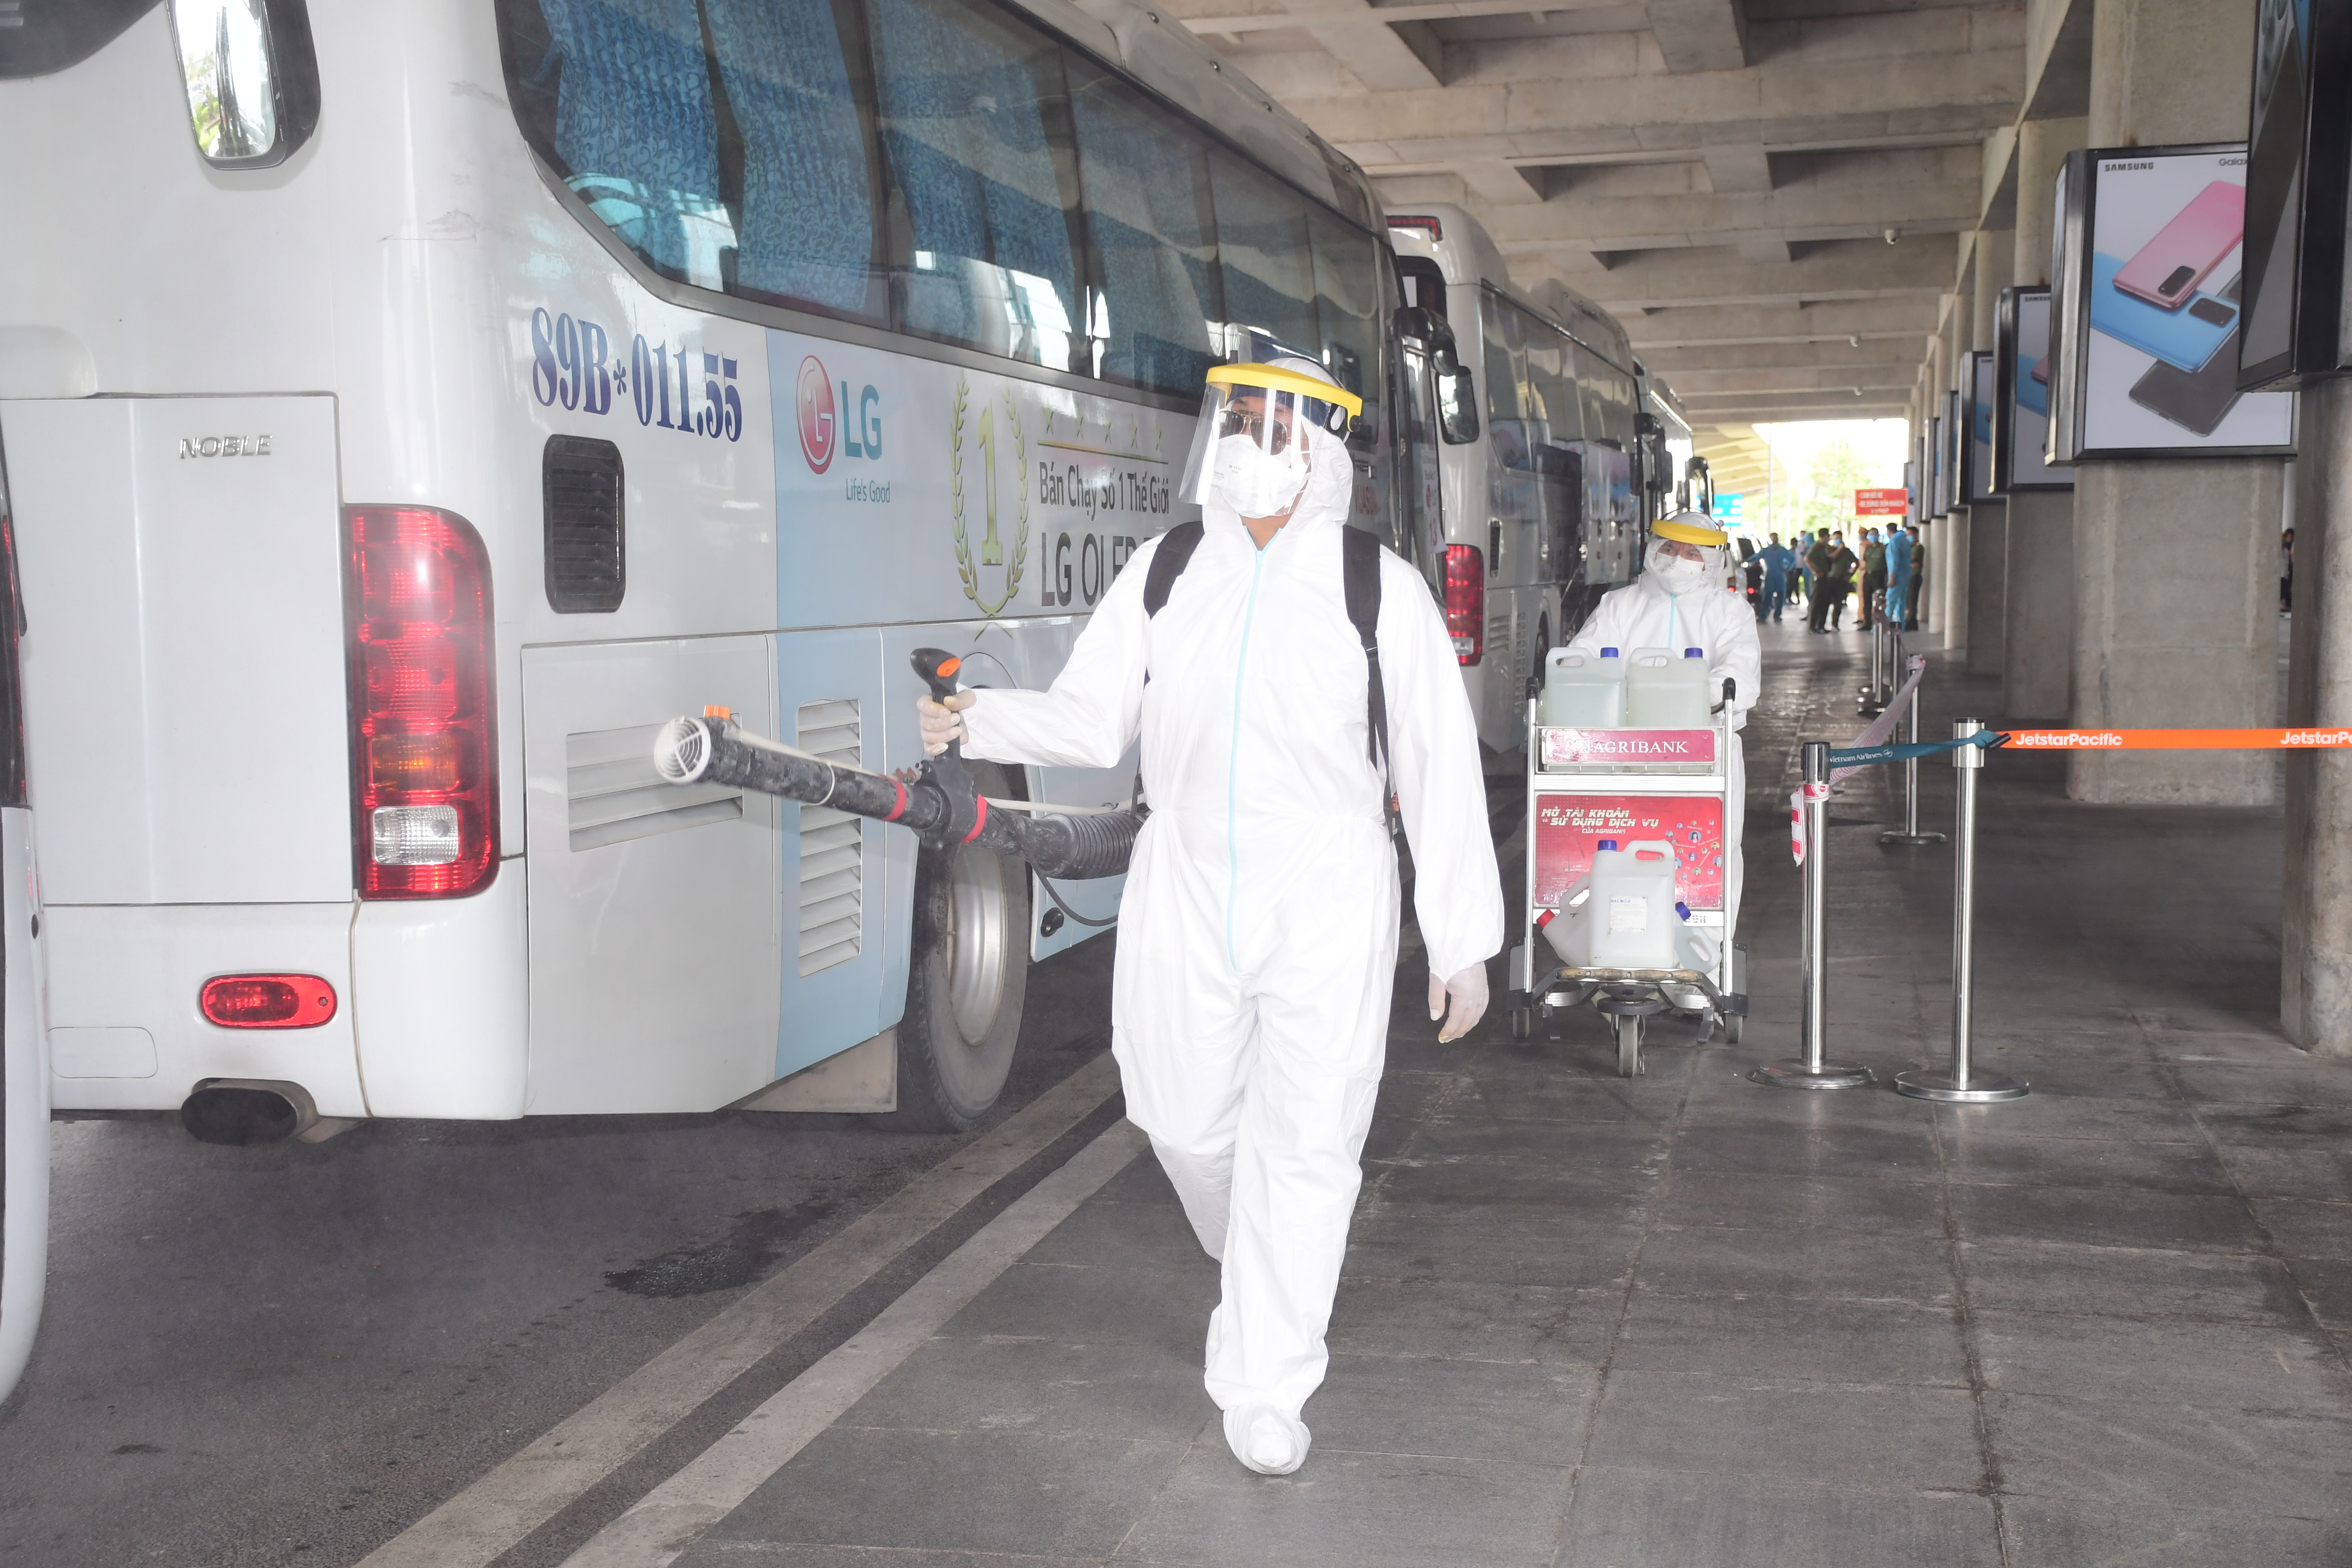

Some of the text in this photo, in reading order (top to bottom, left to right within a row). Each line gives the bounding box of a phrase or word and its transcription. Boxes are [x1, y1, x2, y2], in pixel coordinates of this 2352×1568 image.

[2105, 162, 2153, 172] SAMSUNG
[841, 381, 882, 460] LG
[180, 435, 273, 459] NOBLE
[846, 478, 890, 503] Life's Good
[1040, 462, 1169, 521] Bán Chạy Số 1 Thế Giới
[1042, 532, 1072, 607] LG
[2016, 733, 2122, 746] JetstarPacific
[1593, 741, 1688, 754] AGRIBANK
[1857, 752, 1883, 761] Airlines
[1541, 806, 1630, 818] MỞ TÀI KHOẢN
[1550, 815, 1568, 826] SỬ
[1572, 818, 1604, 828] DỤNG
[1608, 818, 1636, 828] DỊCH
[1642, 819, 1659, 829] VỤ
